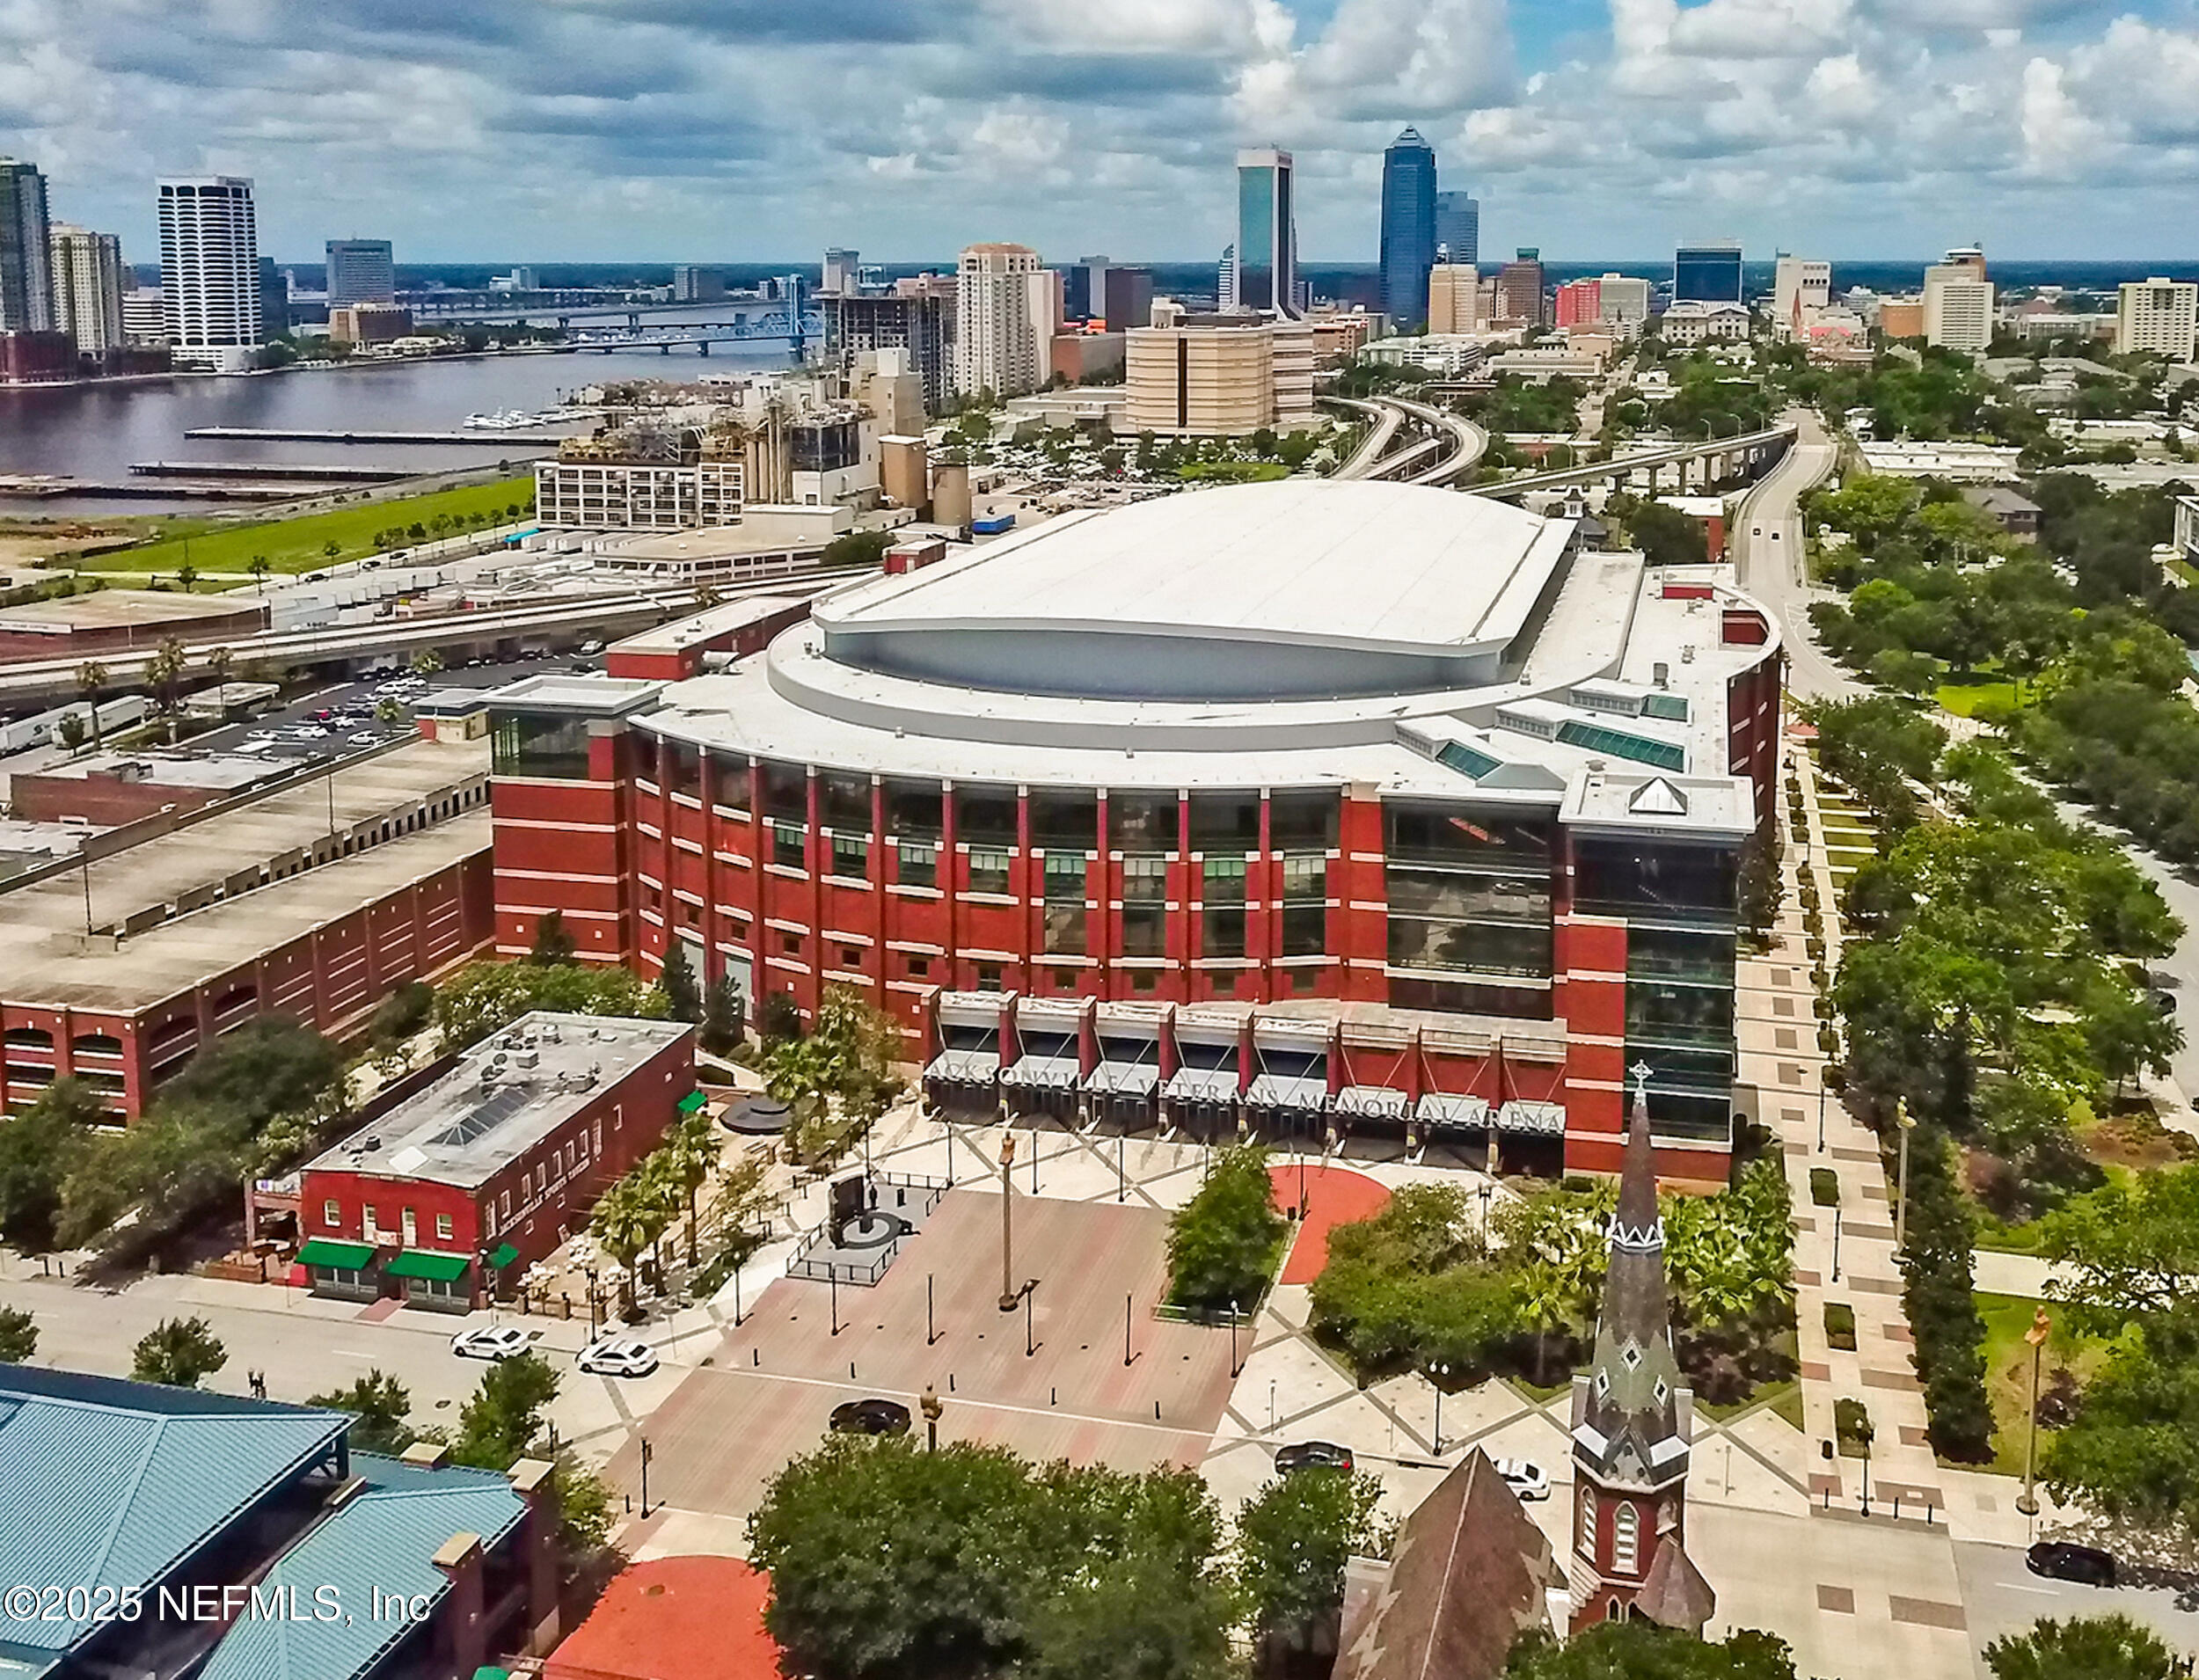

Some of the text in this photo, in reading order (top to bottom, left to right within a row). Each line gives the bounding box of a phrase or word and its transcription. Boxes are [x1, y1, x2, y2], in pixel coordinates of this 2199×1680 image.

[1138, 1077, 1279, 1108] VETERANS
[1297, 1091, 1456, 1125] MEMORIAL
[1466, 1107, 1565, 1135] ARENA
